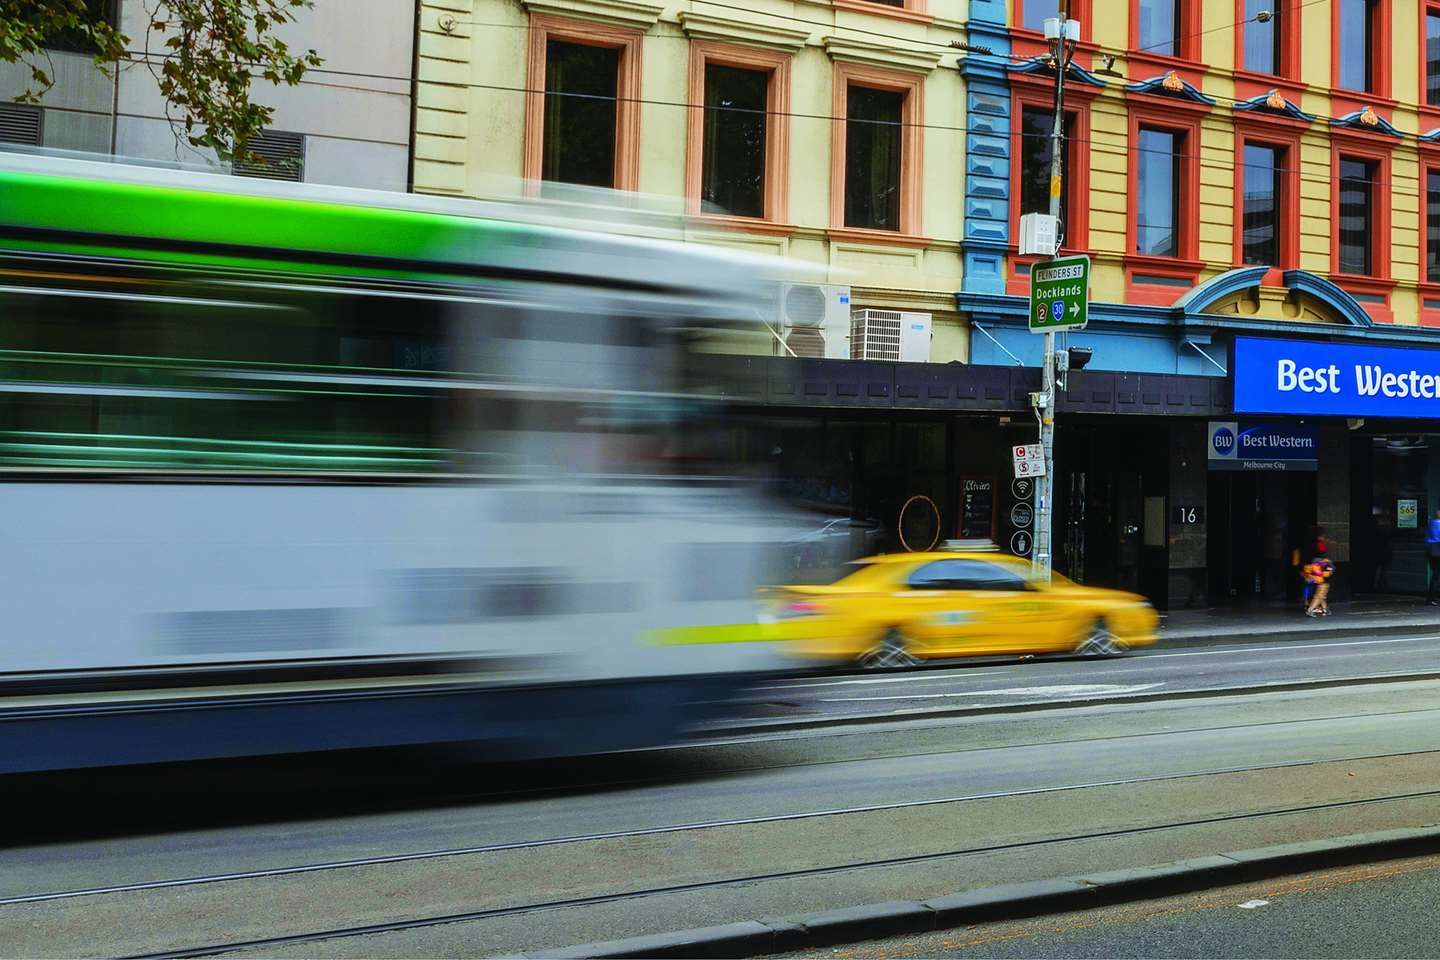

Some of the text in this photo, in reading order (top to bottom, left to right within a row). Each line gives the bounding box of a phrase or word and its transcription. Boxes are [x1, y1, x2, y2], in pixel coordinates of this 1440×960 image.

[1037, 266, 1082, 280] FLINDERS ST
[1036, 285, 1081, 299] Docklands
[1040, 309, 1045, 320] 2
[1054, 304, 1063, 315] 30
[1277, 359, 1341, 394] Best
[1215, 435, 1233, 448] BW
[1243, 434, 1313, 448] Best Western
[1243, 461, 1286, 470] Melbourne City
[1180, 507, 1196, 523] 16
